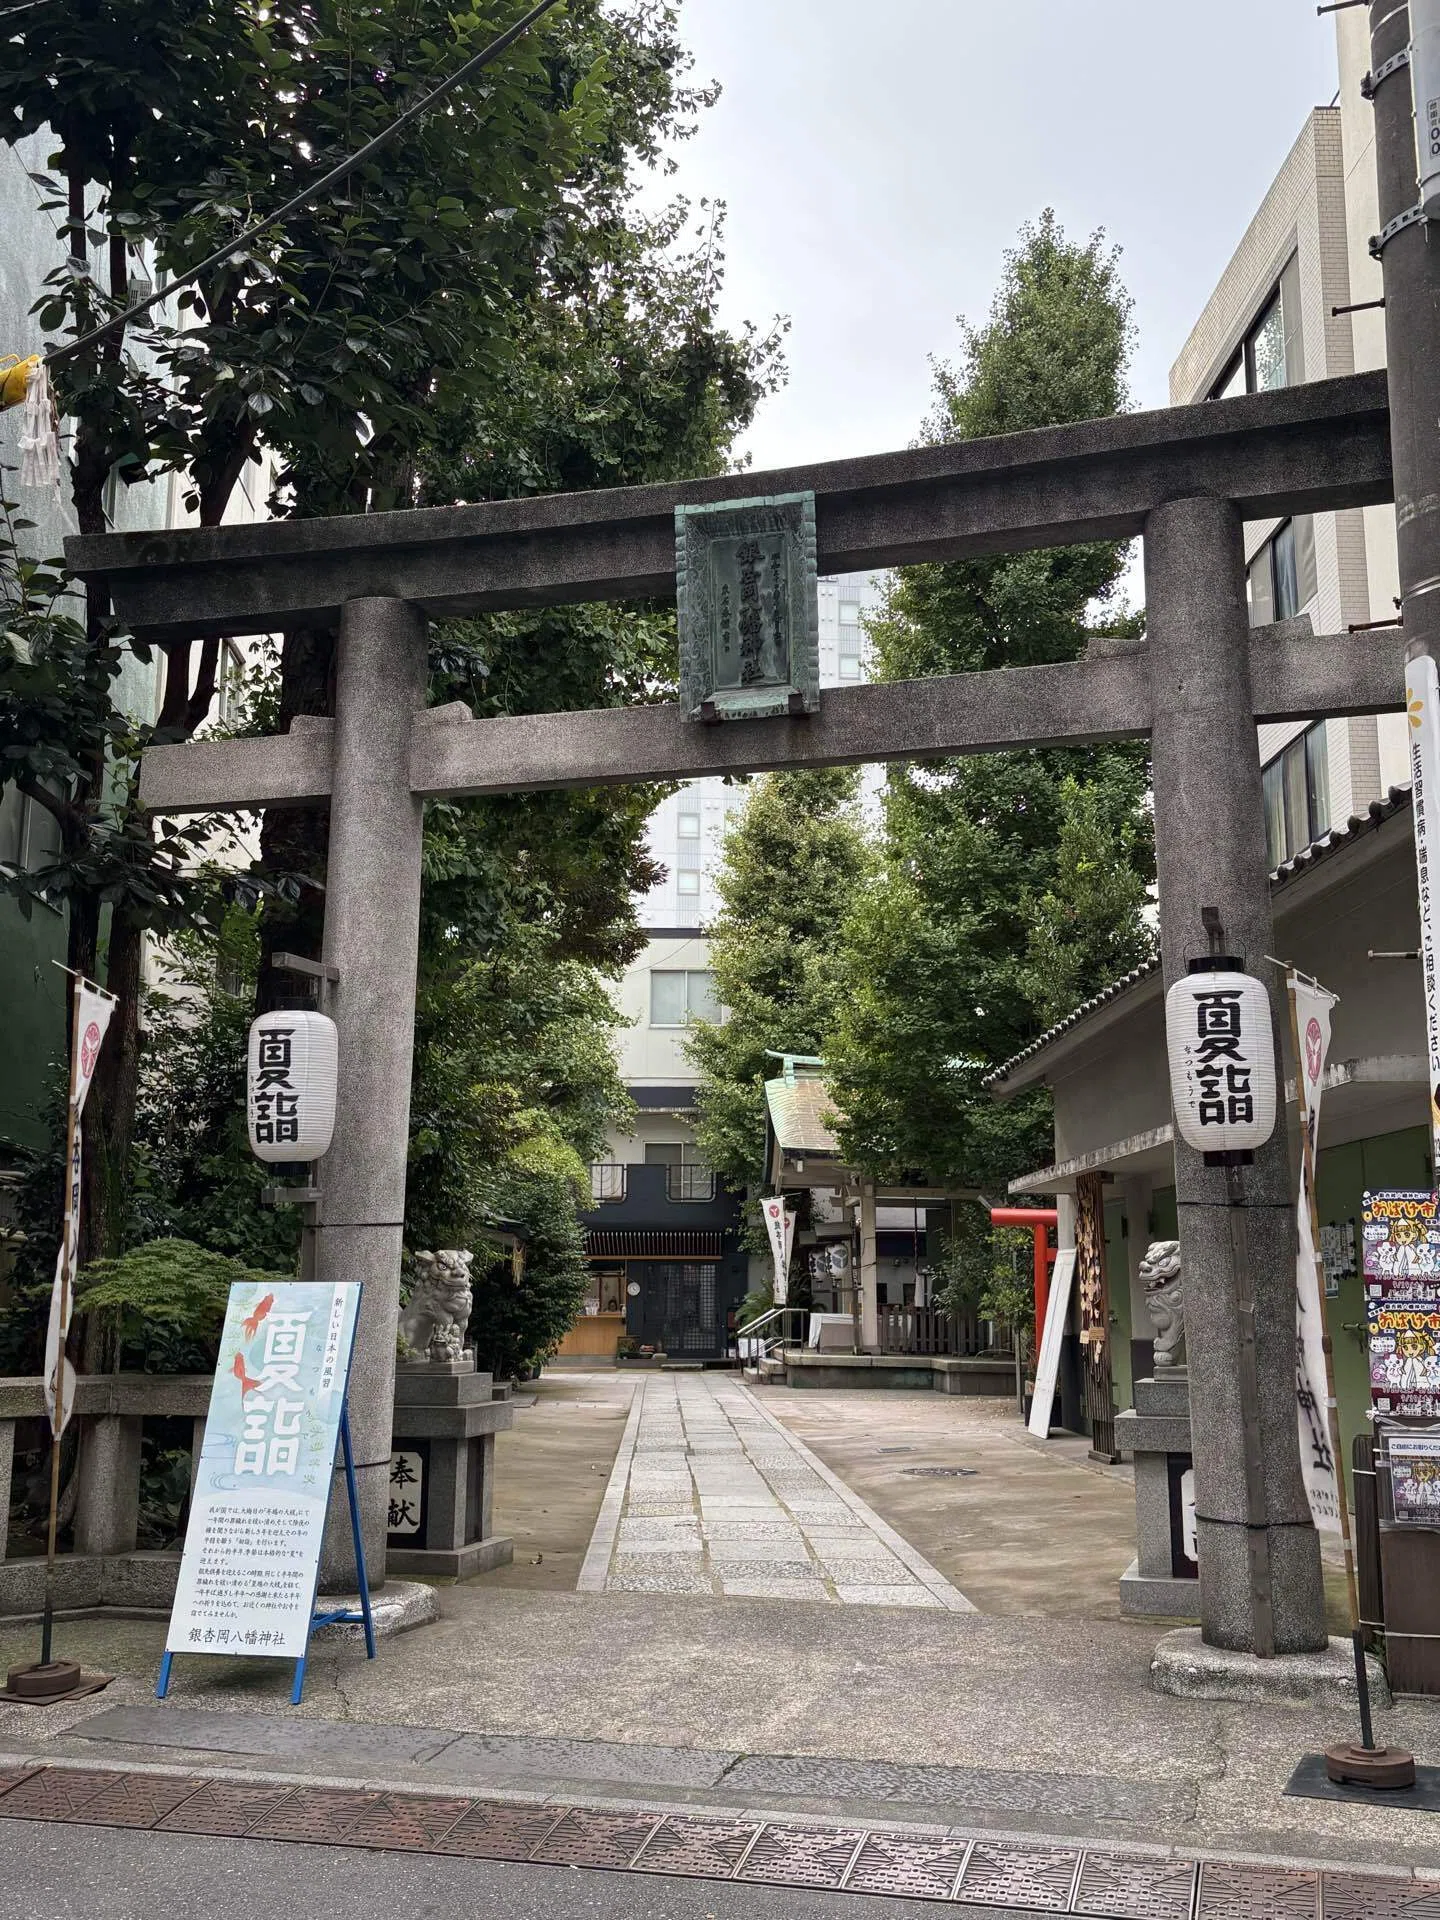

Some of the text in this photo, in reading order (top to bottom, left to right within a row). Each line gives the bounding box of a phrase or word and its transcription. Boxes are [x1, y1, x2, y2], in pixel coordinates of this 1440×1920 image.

[255, 1028, 300, 1144] 夏詣
[1184, 1044, 1197, 1109] なつもうで
[1192, 990, 1254, 1126] 夏詣
[1371, 1200, 1437, 1218] おばけ市
[322, 1297, 344, 1389] 新しい日本の風習
[1378, 1311, 1440, 1329] おばけ市
[233, 1310, 311, 1477] 夏詣
[388, 1455, 418, 1528] 奉献
[188, 1627, 286, 1646] 銀杏岡八幡神社
